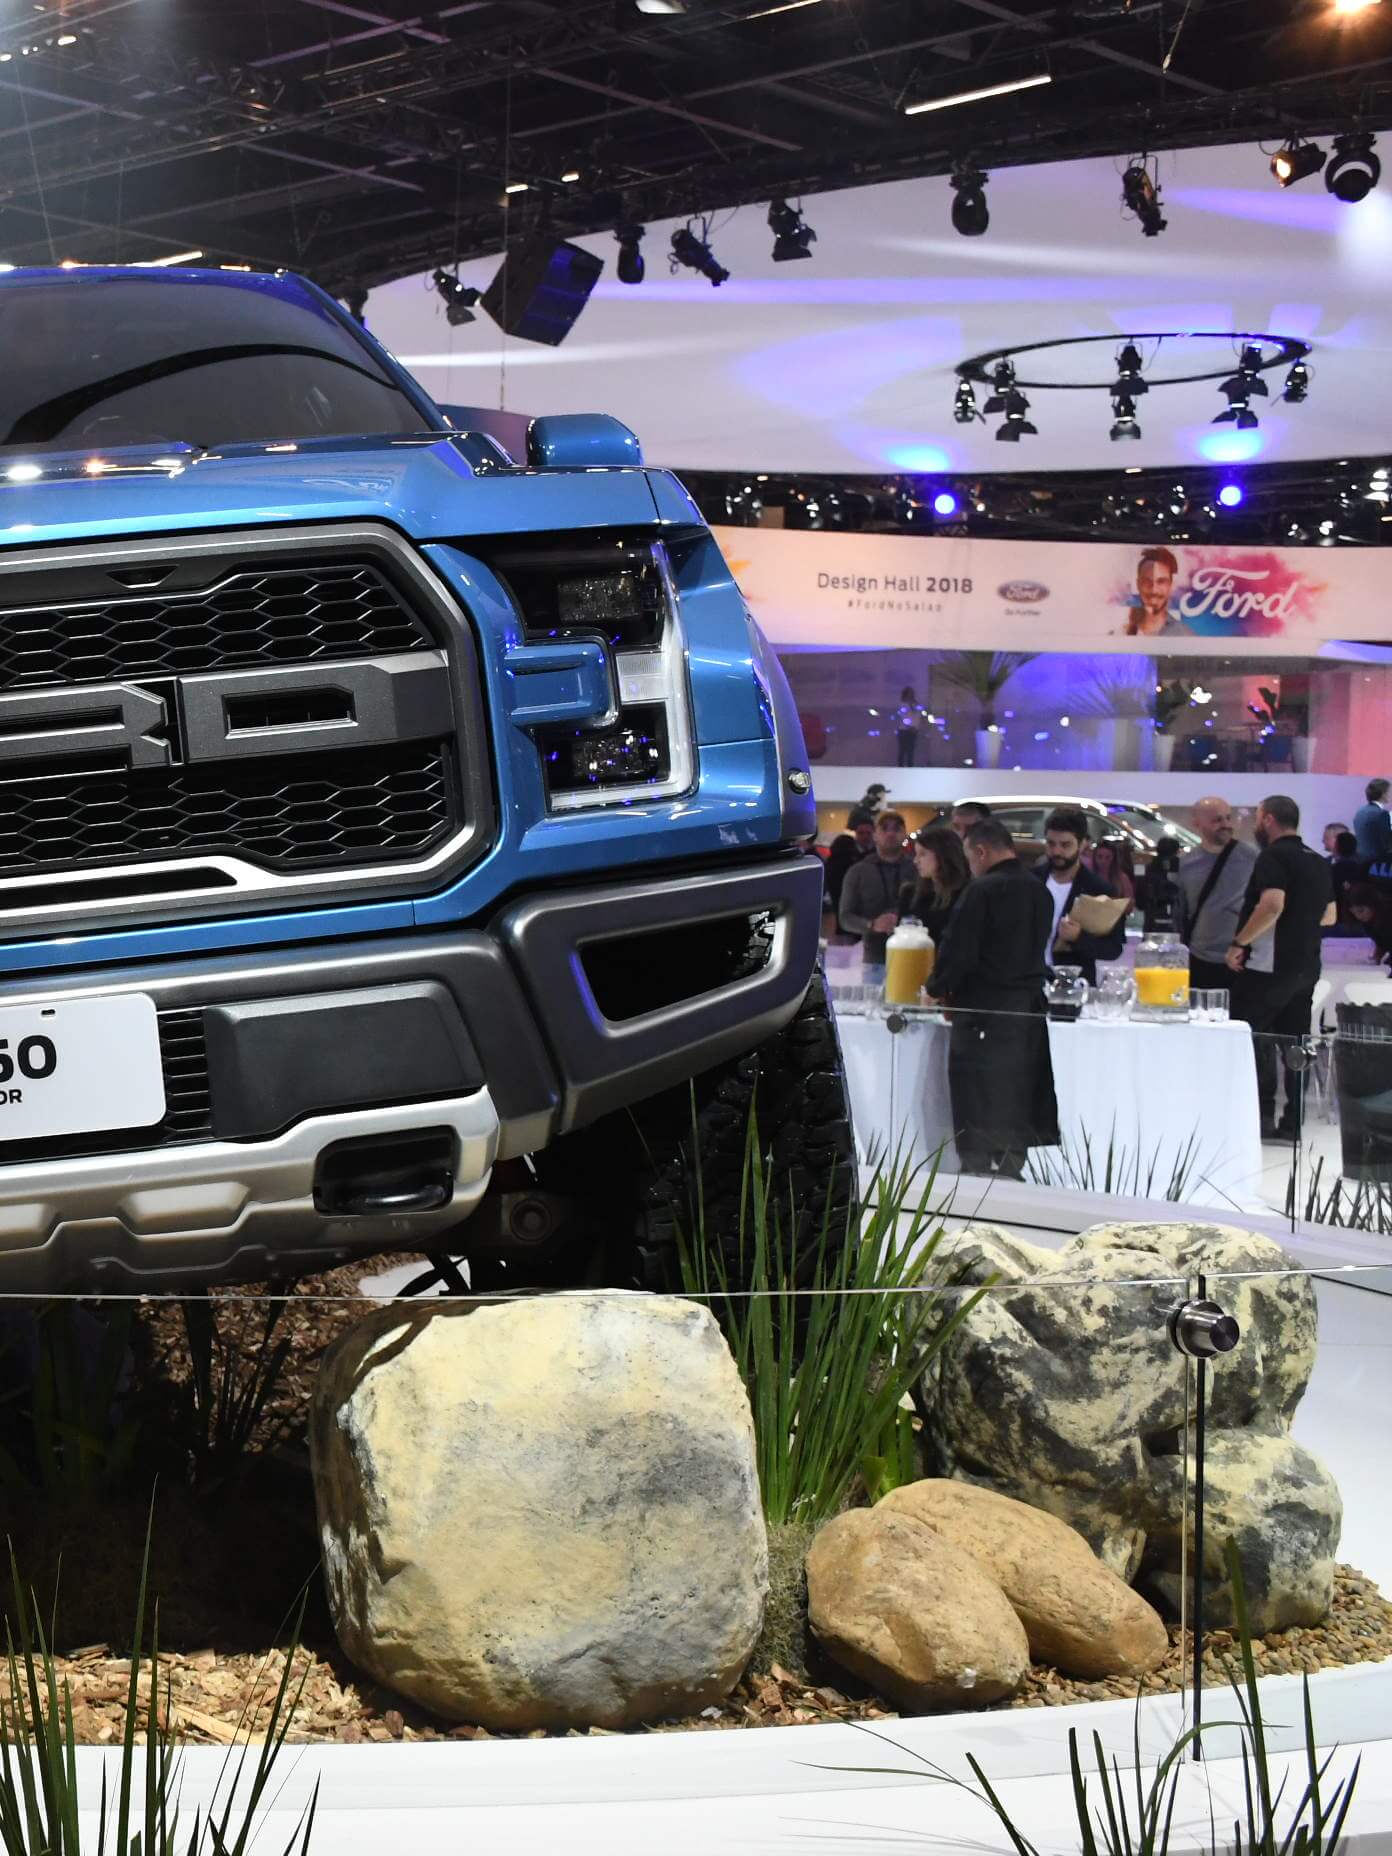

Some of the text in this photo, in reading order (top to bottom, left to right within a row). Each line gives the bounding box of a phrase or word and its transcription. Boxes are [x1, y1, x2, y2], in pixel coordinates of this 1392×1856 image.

[817, 573, 973, 594] Design Hall 2018
[1180, 567, 1299, 618] Ford
